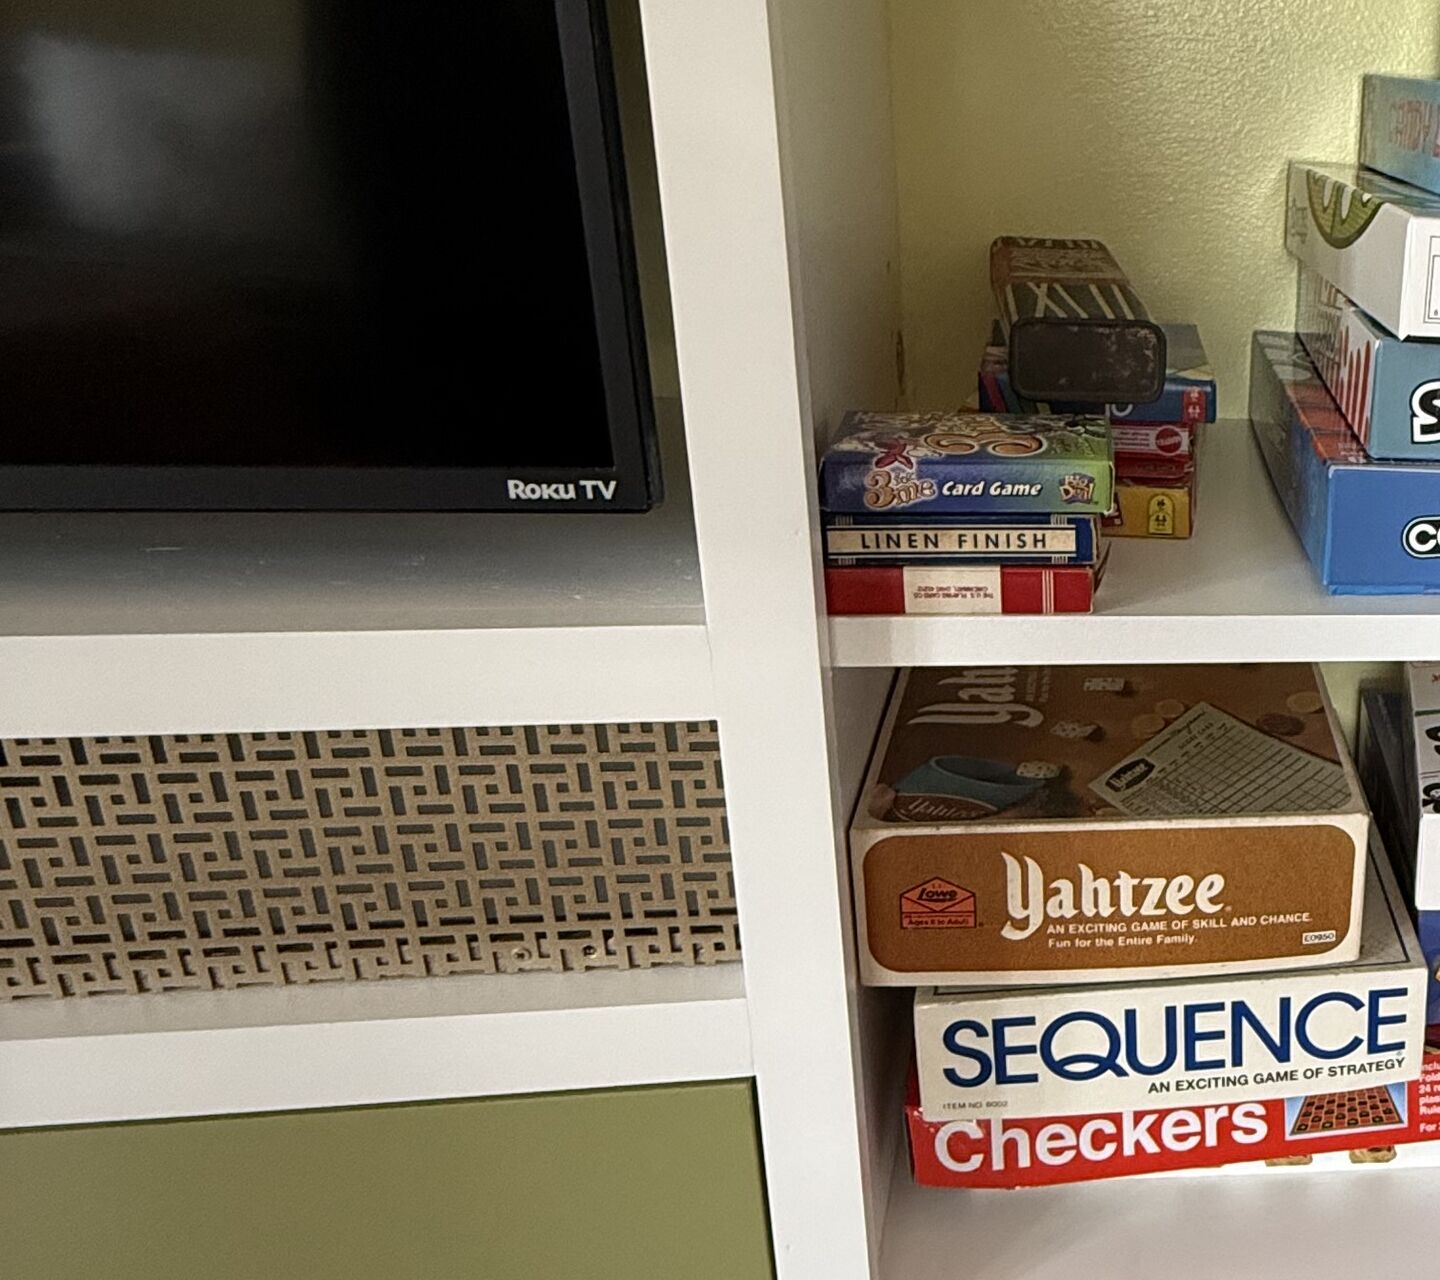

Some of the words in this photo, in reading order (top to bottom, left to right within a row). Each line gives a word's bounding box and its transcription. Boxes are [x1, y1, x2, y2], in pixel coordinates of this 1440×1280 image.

[507, 479, 576, 500] Roku
[579, 480, 617, 500] TV
[866, 470, 896, 508] 3
[942, 480, 986, 496] Card
[989, 480, 1043, 496] Game
[861, 534, 939, 550] LINEN
[957, 533, 1047, 549] FINISH
[917, 888, 958, 900] Lowe
[1000, 851, 1226, 941] Yahtzee
[1047, 924, 1065, 935] AN
[1068, 921, 1128, 934] EXCITING
[1131, 920, 1168, 933] GAME
[1171, 919, 1190, 931] OF
[1192, 918, 1226, 930] SKILL
[1230, 916, 1257, 927] AND
[1048, 938, 1071, 949] Fun
[1075, 937, 1094, 948] for
[1095, 936, 1115, 947] the
[1118, 935, 1153, 947] Entire
[1156, 933, 1198, 947] Family.
[942, 987, 1409, 1089] SEQUENCE
[1148, 1082, 1171, 1094] AN
[1175, 1074, 1249, 1092] EXCITING
[1253, 1069, 1299, 1085] GAME
[1303, 1068, 1323, 1080] OF
[1327, 1057, 1406, 1077] STRATEGY
[1418, 1084, 1431, 1094] 24
[943, 1102, 967, 1110] ITEM
[1420, 1122, 1437, 1133] For
[934, 1102, 1268, 1173] Checkers
